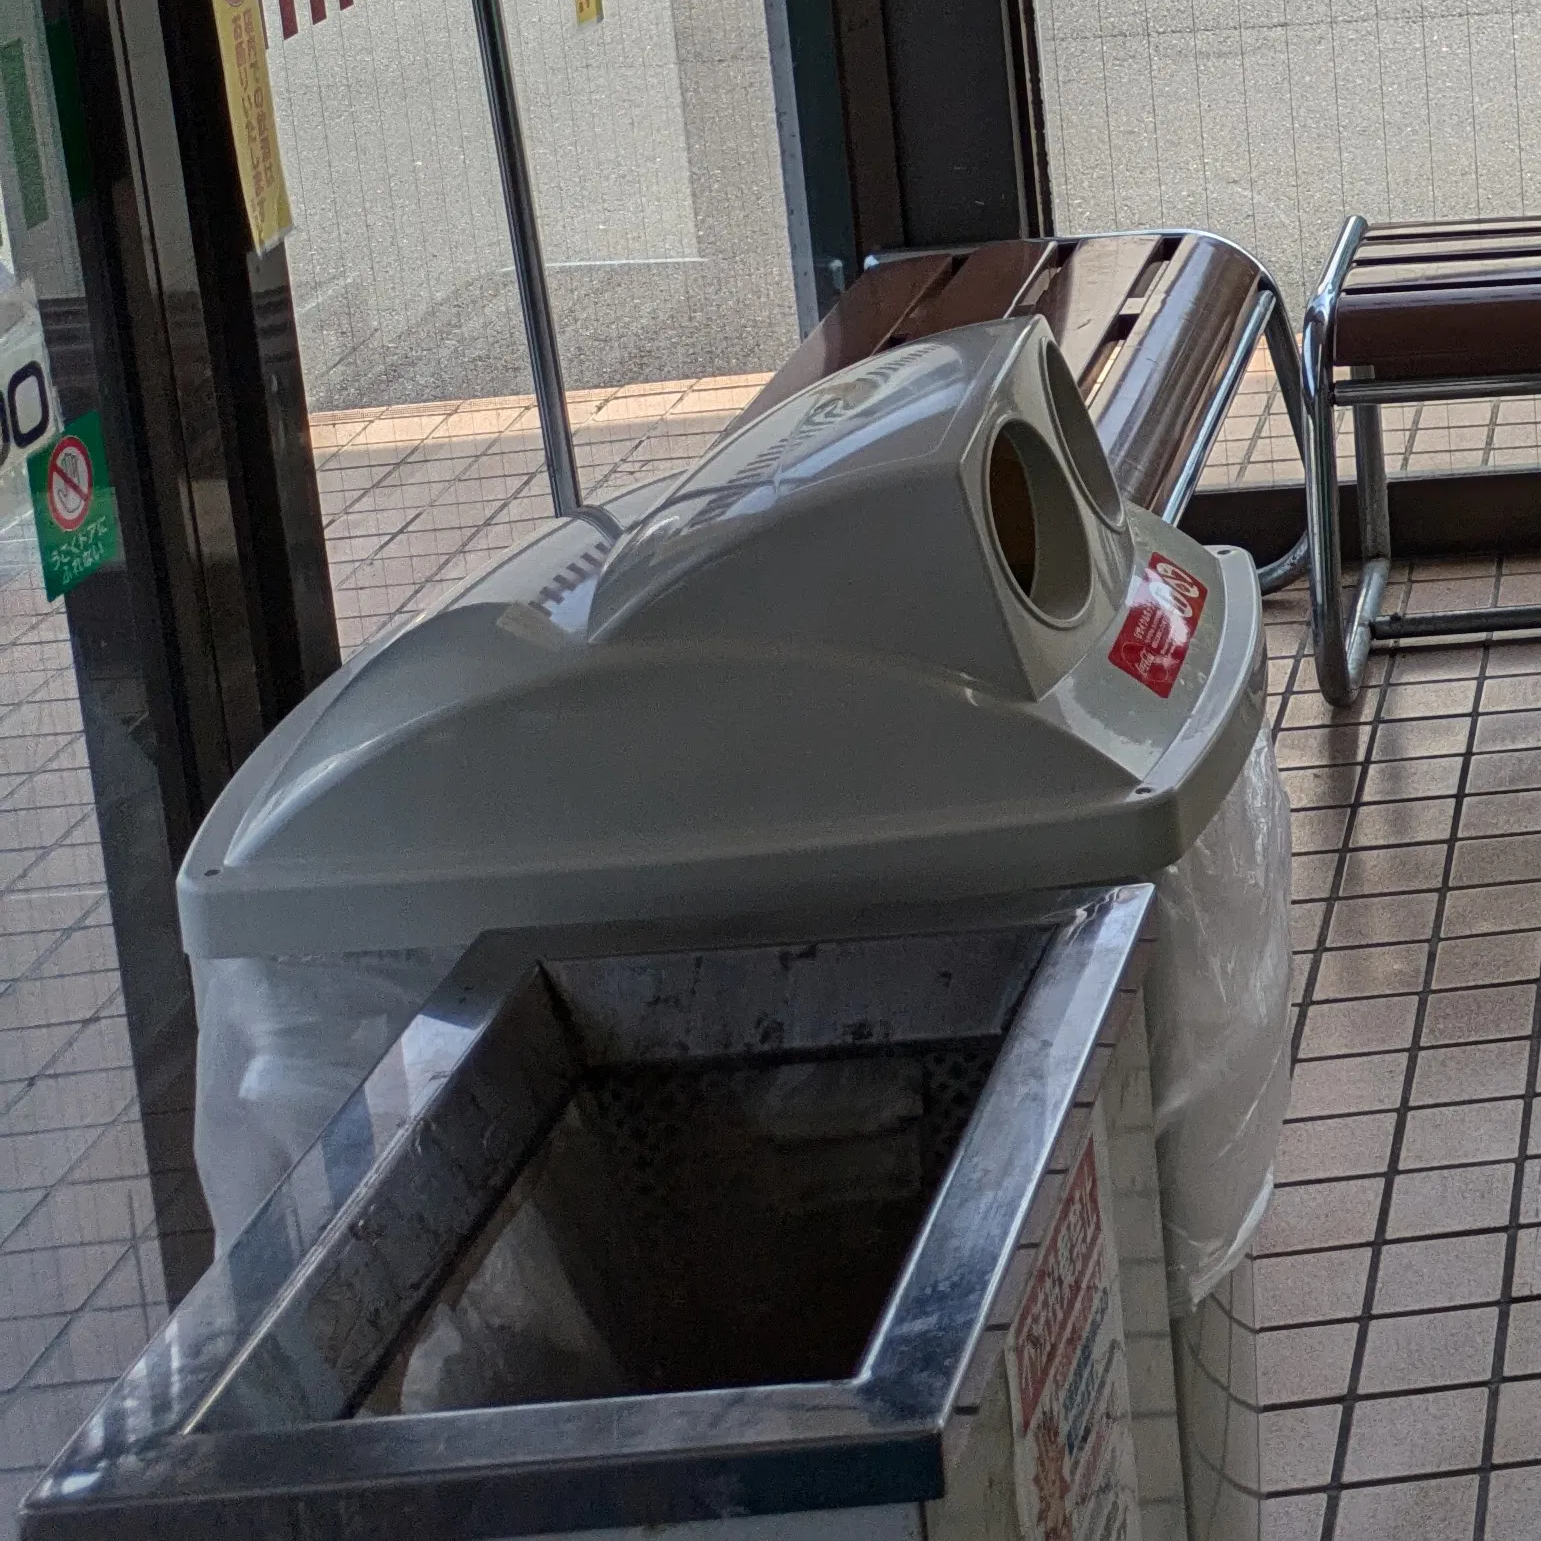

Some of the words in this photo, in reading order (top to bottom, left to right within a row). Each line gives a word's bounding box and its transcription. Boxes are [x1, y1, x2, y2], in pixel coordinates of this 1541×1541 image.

[52, 516, 108, 571] うごくドアに
